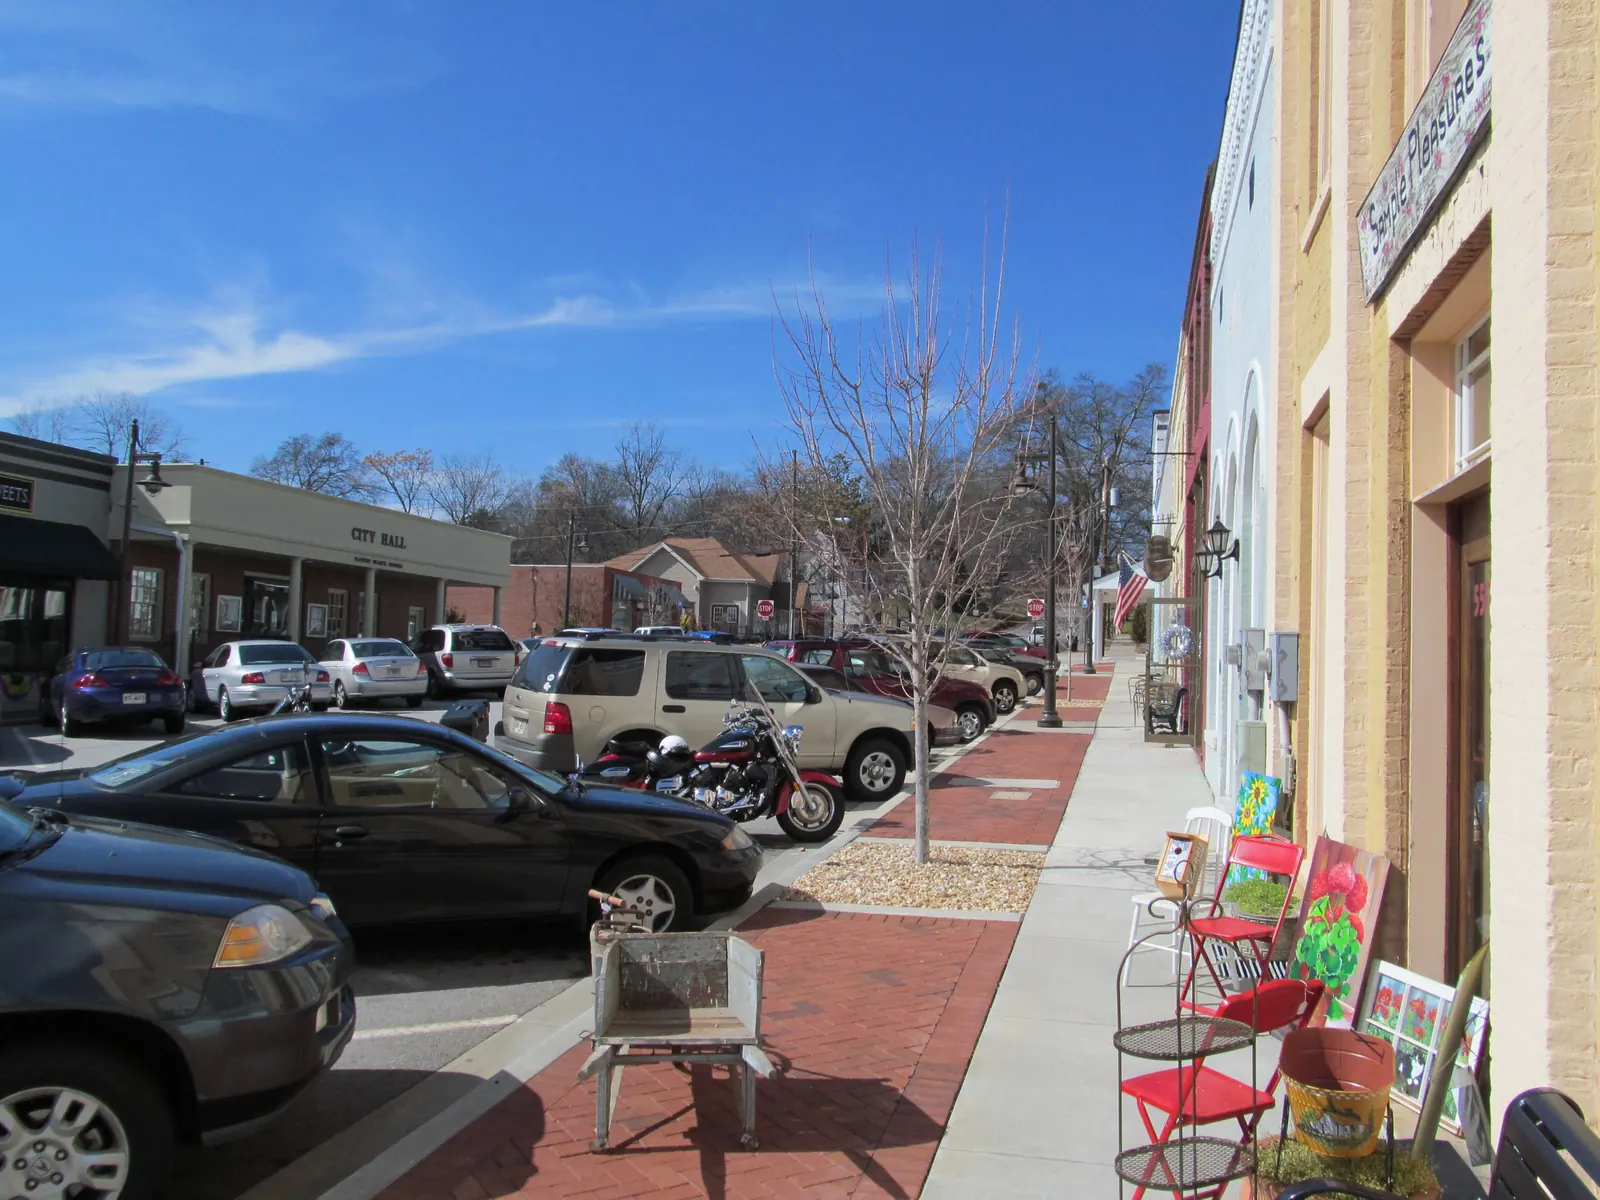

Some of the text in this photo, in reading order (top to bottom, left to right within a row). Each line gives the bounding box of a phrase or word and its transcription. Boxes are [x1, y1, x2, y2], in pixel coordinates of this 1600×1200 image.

[351, 527, 407, 549] CITY HALL
[1028, 604, 1044, 612] STOP
